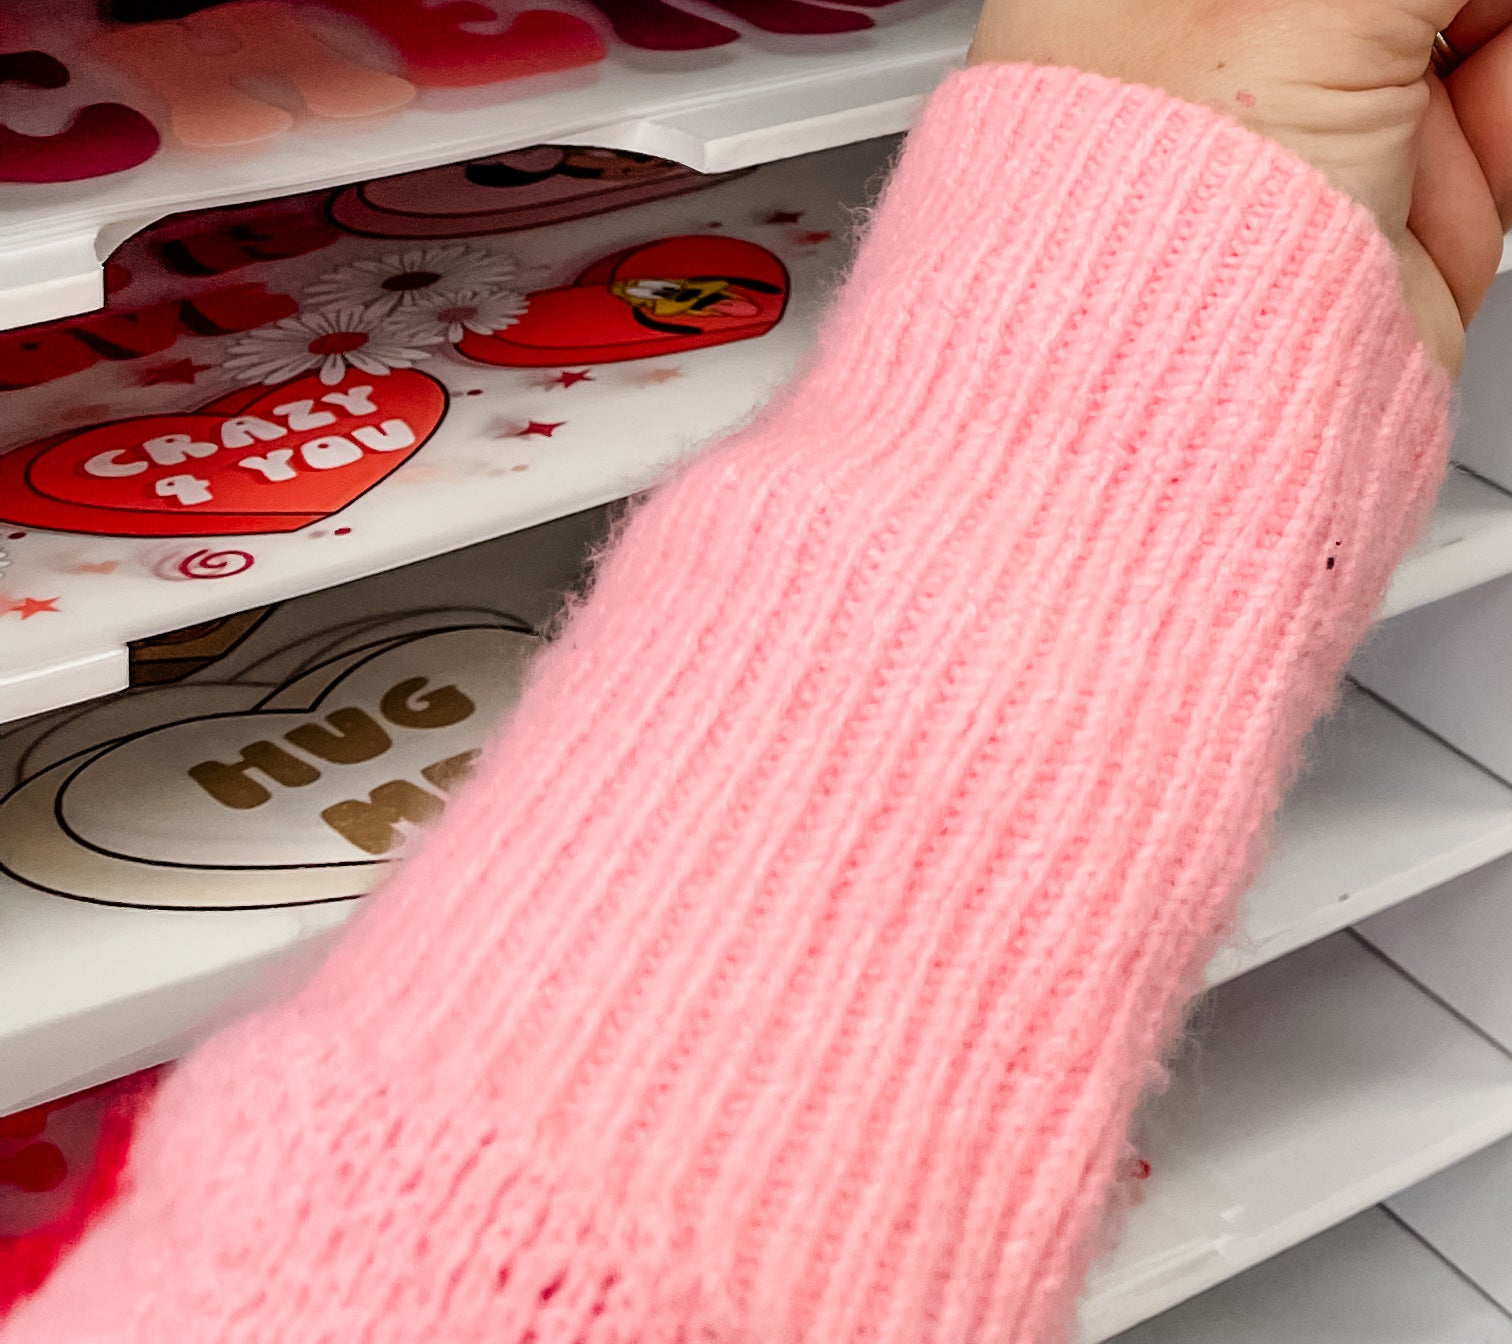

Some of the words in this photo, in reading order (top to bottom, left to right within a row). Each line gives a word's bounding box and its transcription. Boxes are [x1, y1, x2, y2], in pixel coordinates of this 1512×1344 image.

[83, 385, 381, 479] CRAZY
[154, 474, 213, 506] 4
[238, 418, 416, 483] YOU
[188, 676, 475, 810] HUG
